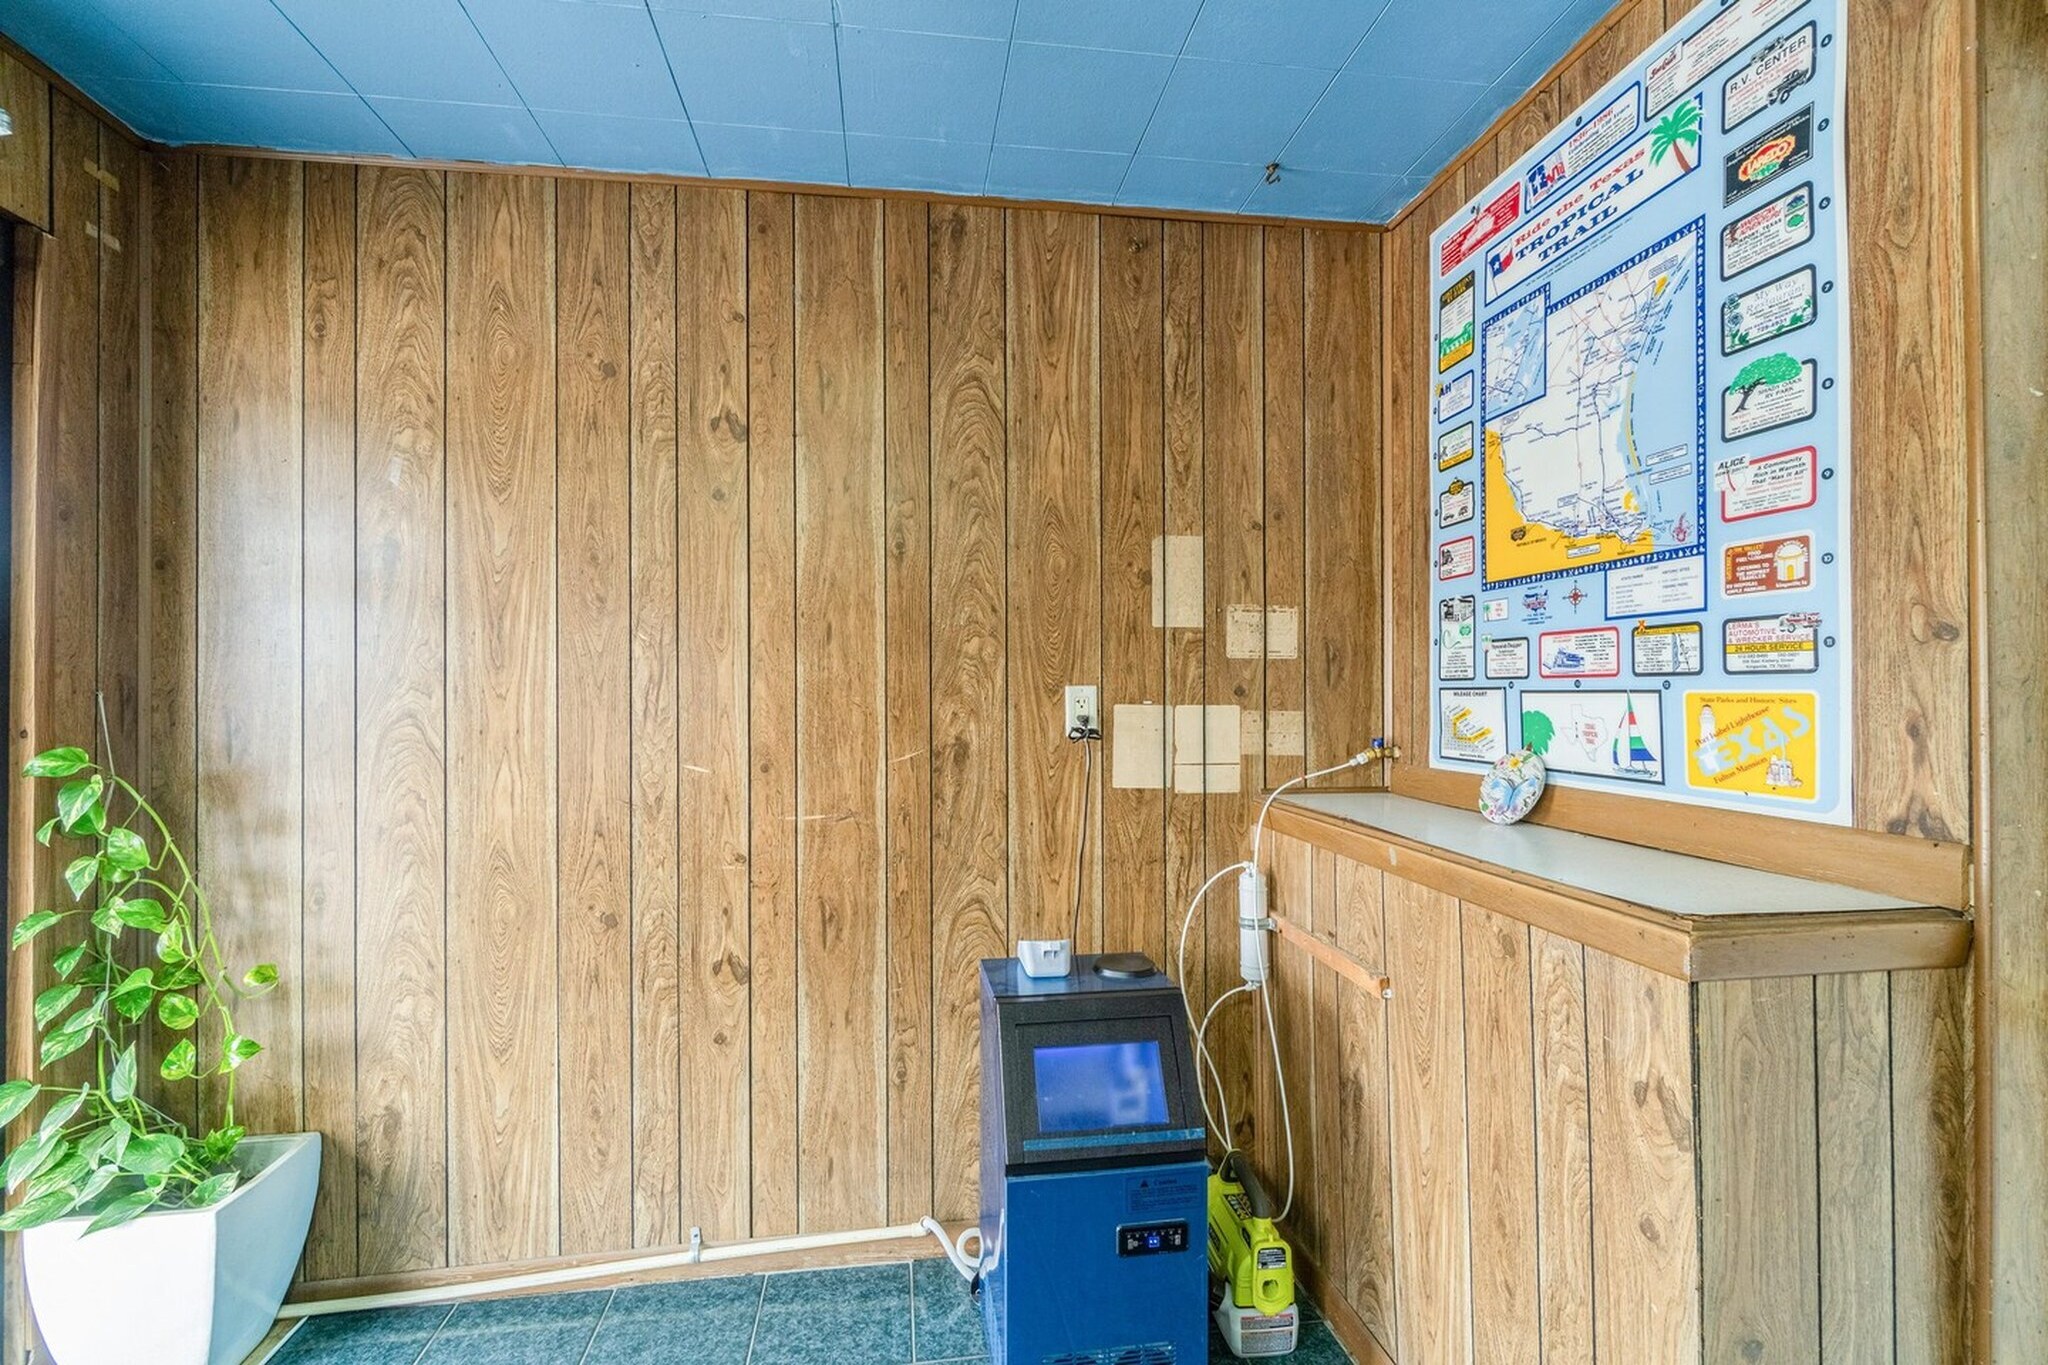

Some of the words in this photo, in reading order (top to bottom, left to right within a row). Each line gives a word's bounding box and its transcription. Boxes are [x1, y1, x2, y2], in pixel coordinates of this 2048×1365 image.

[1729, 73, 1752, 93] R.V.
[1755, 35, 1806, 75] CENTER
[1514, 218, 1550, 247] Ride
[1556, 194, 1583, 216] the
[1590, 148, 1645, 192] Texas
[1515, 168, 1643, 261] TROPICAL
[1539, 205, 1618, 261] TRAIL
[1717, 456, 1746, 470] ALICE
[1763, 457, 1803, 470] Community
[1728, 628, 1777, 637] AUTOMOTIVE
[1736, 635, 1773, 643] WRECKER
[1776, 633, 1810, 641] SERVICE
[1744, 644, 1767, 652] HOUR
[1770, 642, 1802, 650] SERVICE
[1729, 706, 1770, 730] Lighthouse
[1694, 706, 1810, 777] TEXAS
